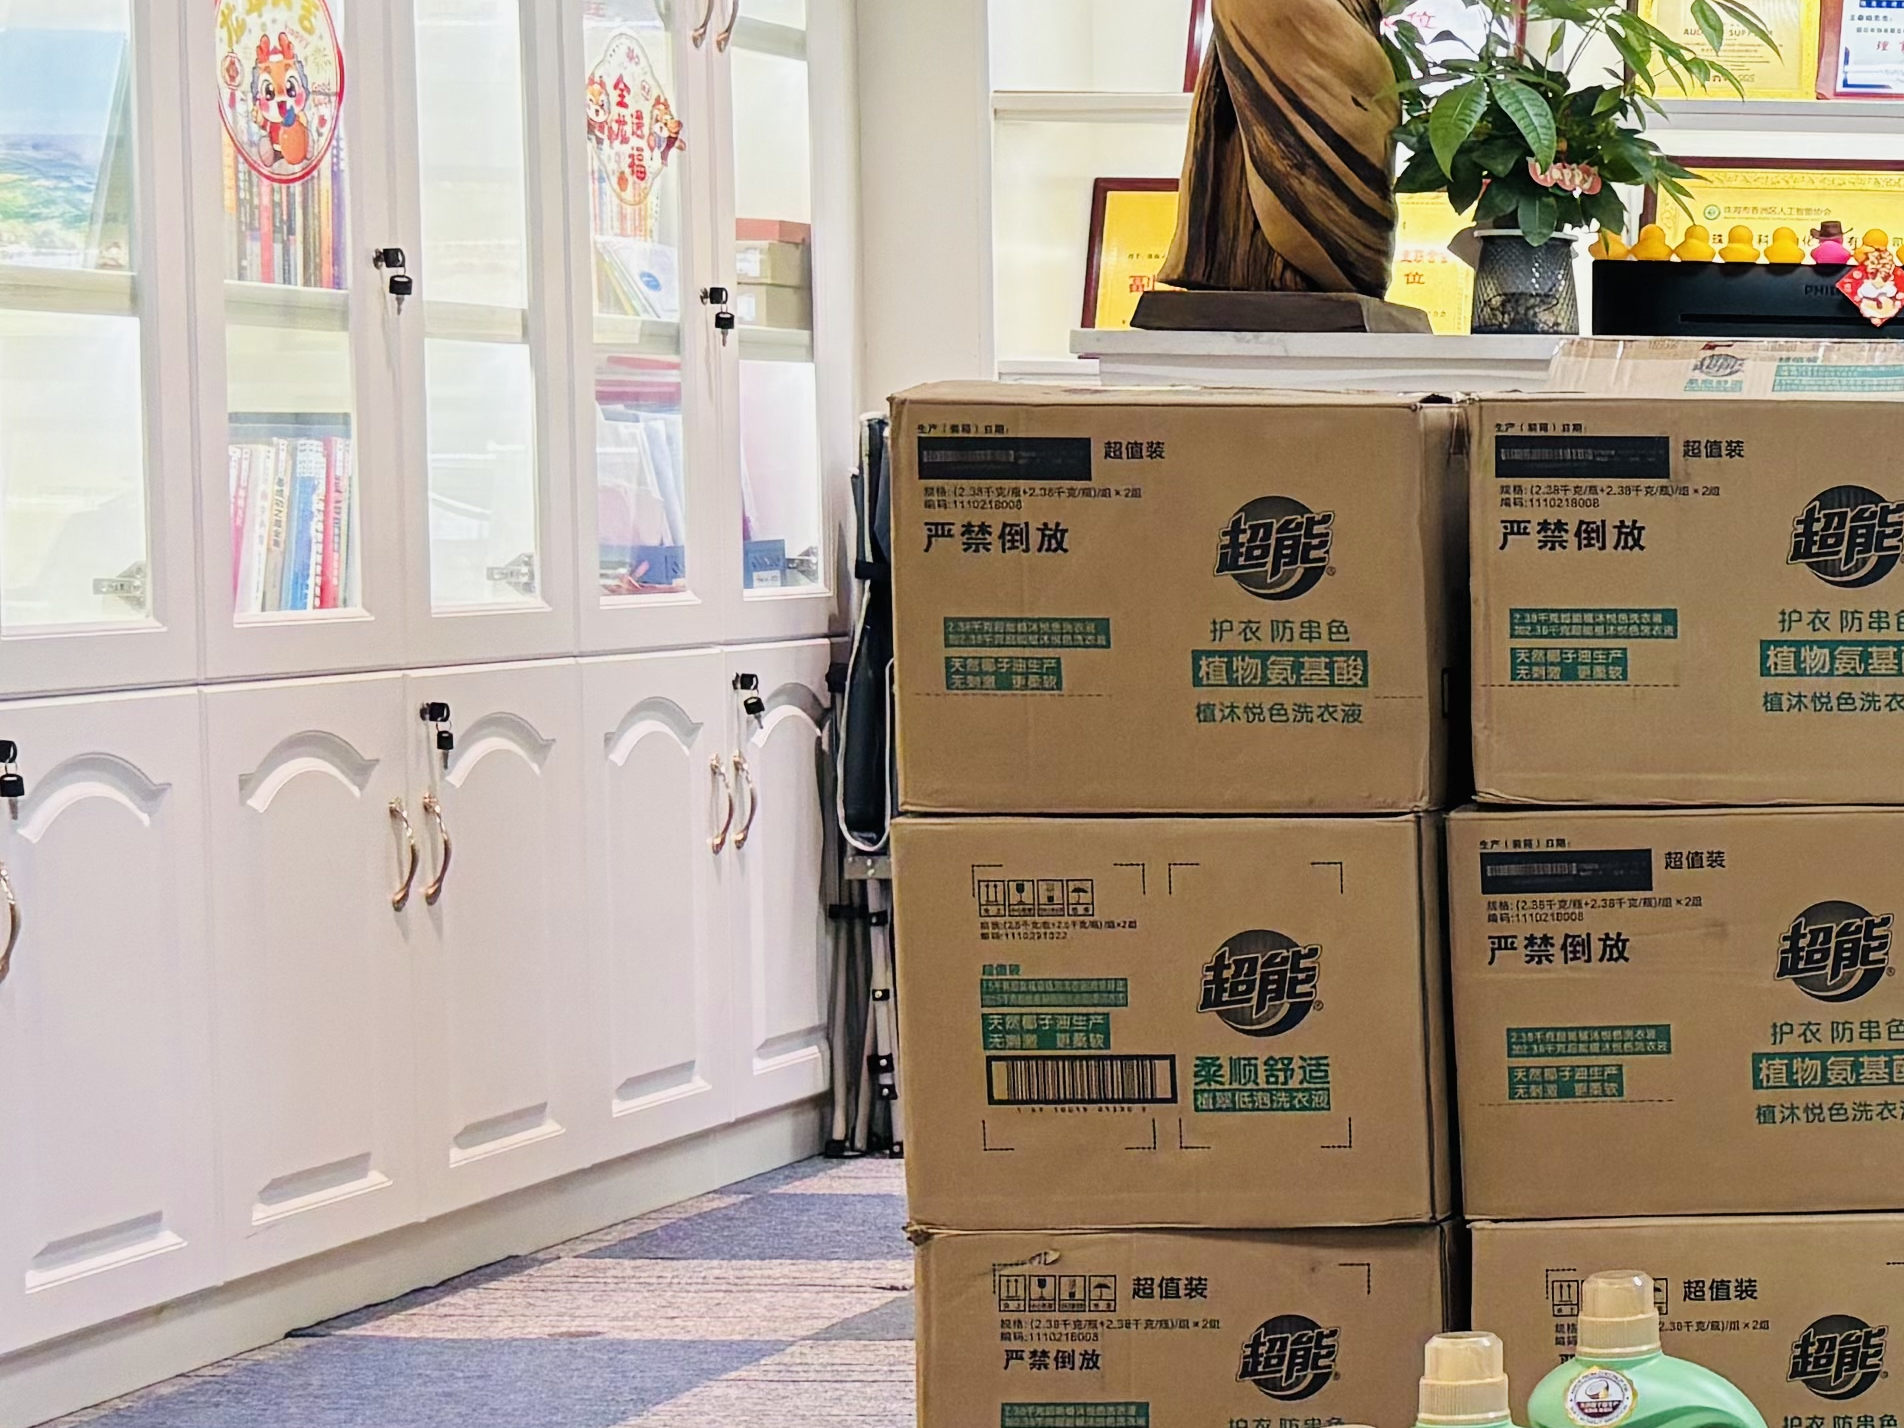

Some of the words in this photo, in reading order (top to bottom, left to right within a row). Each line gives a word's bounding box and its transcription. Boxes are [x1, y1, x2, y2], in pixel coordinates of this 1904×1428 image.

[1103, 441, 1165, 460] 超值装
[1682, 440, 1745, 460] 超值装
[923, 521, 1069, 554] 严禁倒放
[1216, 511, 1334, 583] 超能
[1500, 518, 1646, 552] 严禁倒放
[1210, 619, 1261, 643] 护衣
[1271, 620, 1350, 643] 防串色
[1778, 608, 1829, 634] 护衣
[1199, 656, 1365, 685] 植物氨基酸
[1196, 702, 1363, 724] 植沐悦色洗衣液
[1664, 850, 1726, 871] 超值装
[1488, 932, 1630, 965] 严禁倒放
[1776, 914, 1894, 984] 超能
[1199, 945, 1321, 1015] 超能
[1770, 1019, 1822, 1044] 护衣
[1194, 1056, 1330, 1085] 柔顺舒适
[1132, 1277, 1208, 1300] 超值装
[1682, 1279, 1758, 1300] 超值装
[1004, 1349, 1100, 1370] 严禁倒放
[1237, 1328, 1341, 1384] 超能
[1788, 1326, 1888, 1385] 超能
